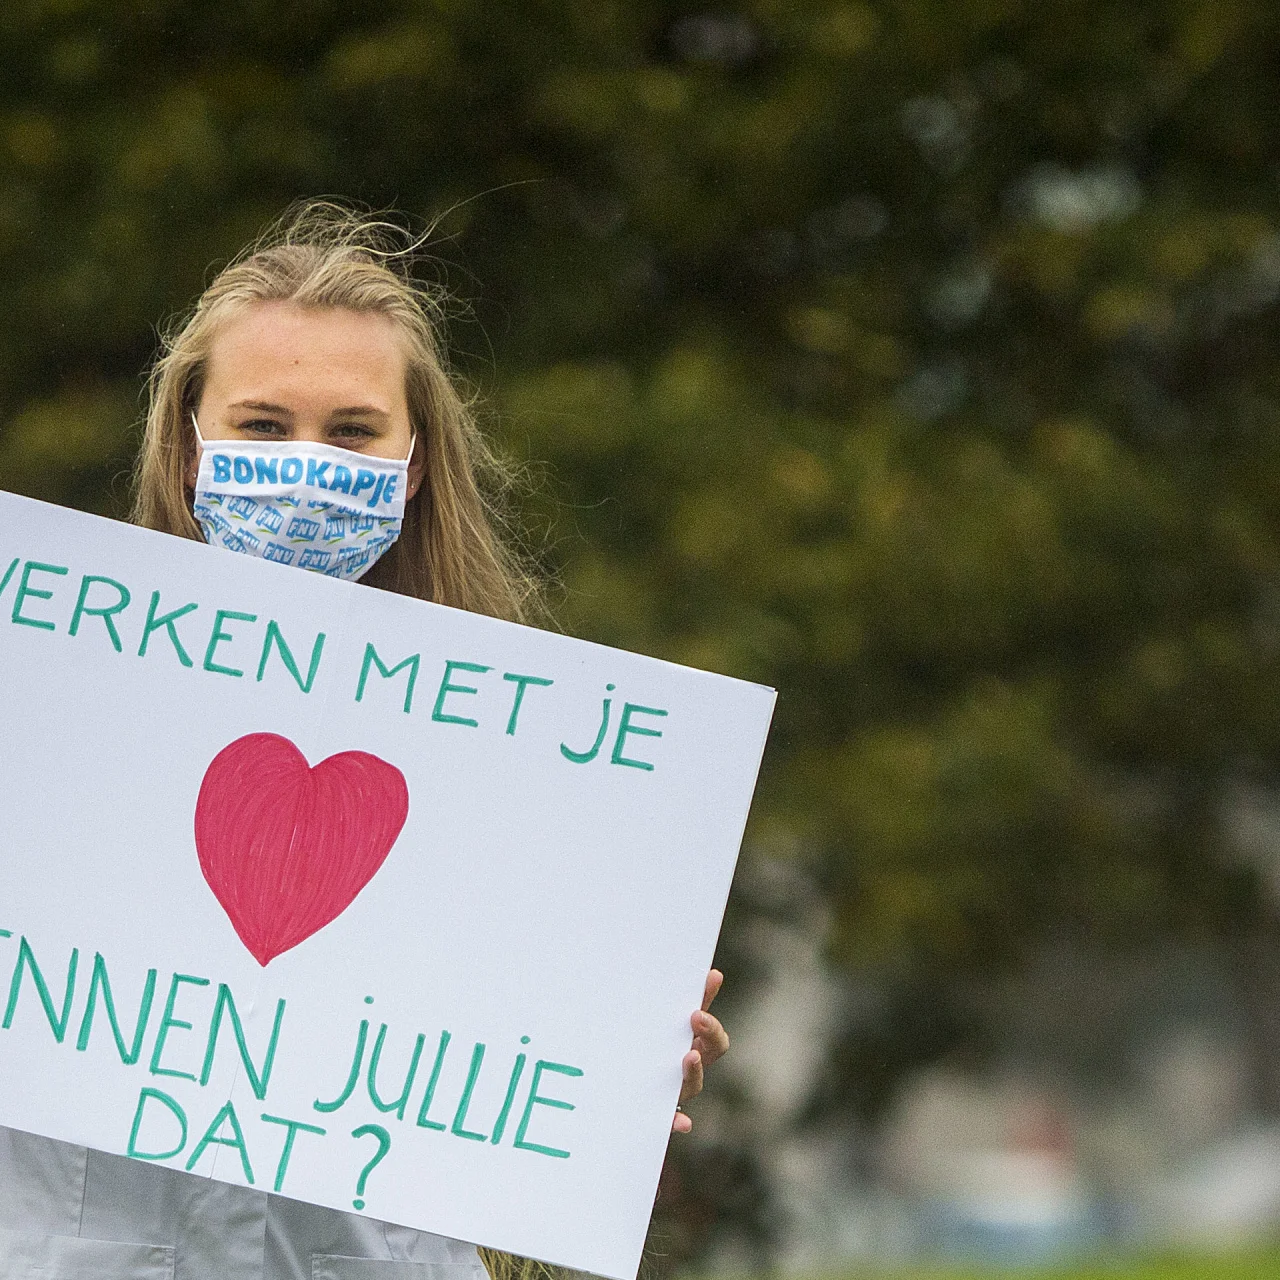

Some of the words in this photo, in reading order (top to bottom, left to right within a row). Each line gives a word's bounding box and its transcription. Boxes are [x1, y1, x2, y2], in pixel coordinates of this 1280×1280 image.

[257, 508, 283, 530] FNV
[287, 519, 320, 538] FNV
[325, 519, 345, 539] FNV
[263, 545, 295, 562] FNV
[299, 551, 331, 569] FNV
[354, 642, 554, 737] MET
[125, 1086, 327, 1193] DAT
